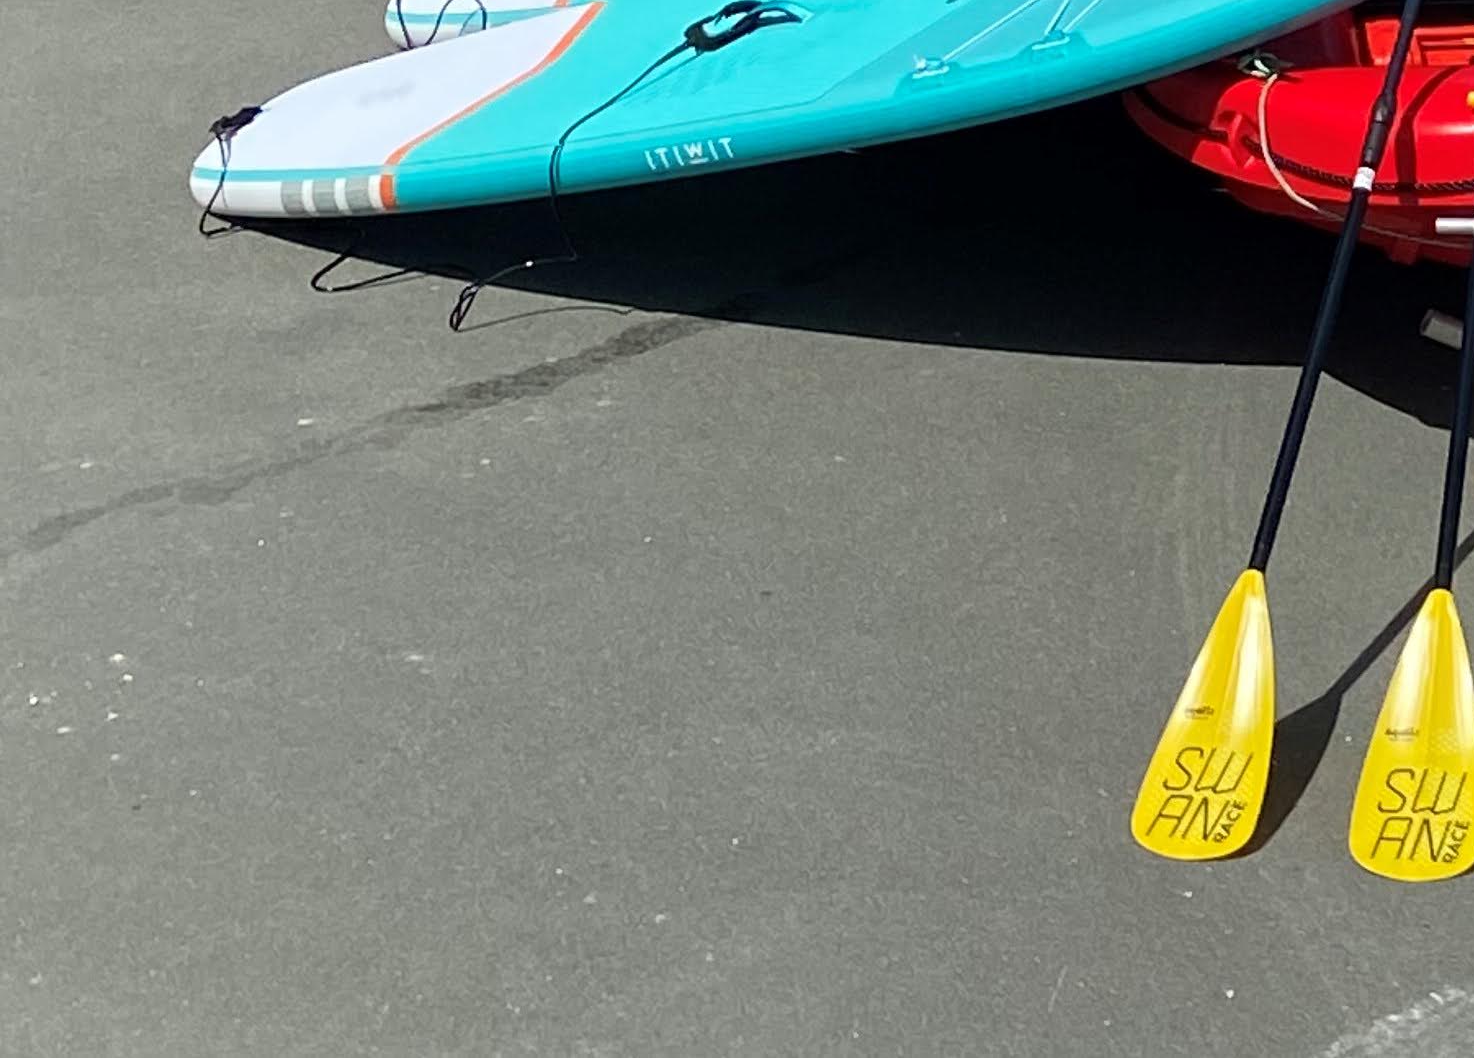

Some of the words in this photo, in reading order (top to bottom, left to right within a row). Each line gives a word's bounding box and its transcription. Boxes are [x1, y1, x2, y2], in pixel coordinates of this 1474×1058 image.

[644, 137, 734, 171] ITIWIT
[1145, 794, 1231, 842] AN
[1212, 799, 1248, 844] RACE
[1369, 816, 1453, 863] AN
[1441, 819, 1471, 864] RACE
